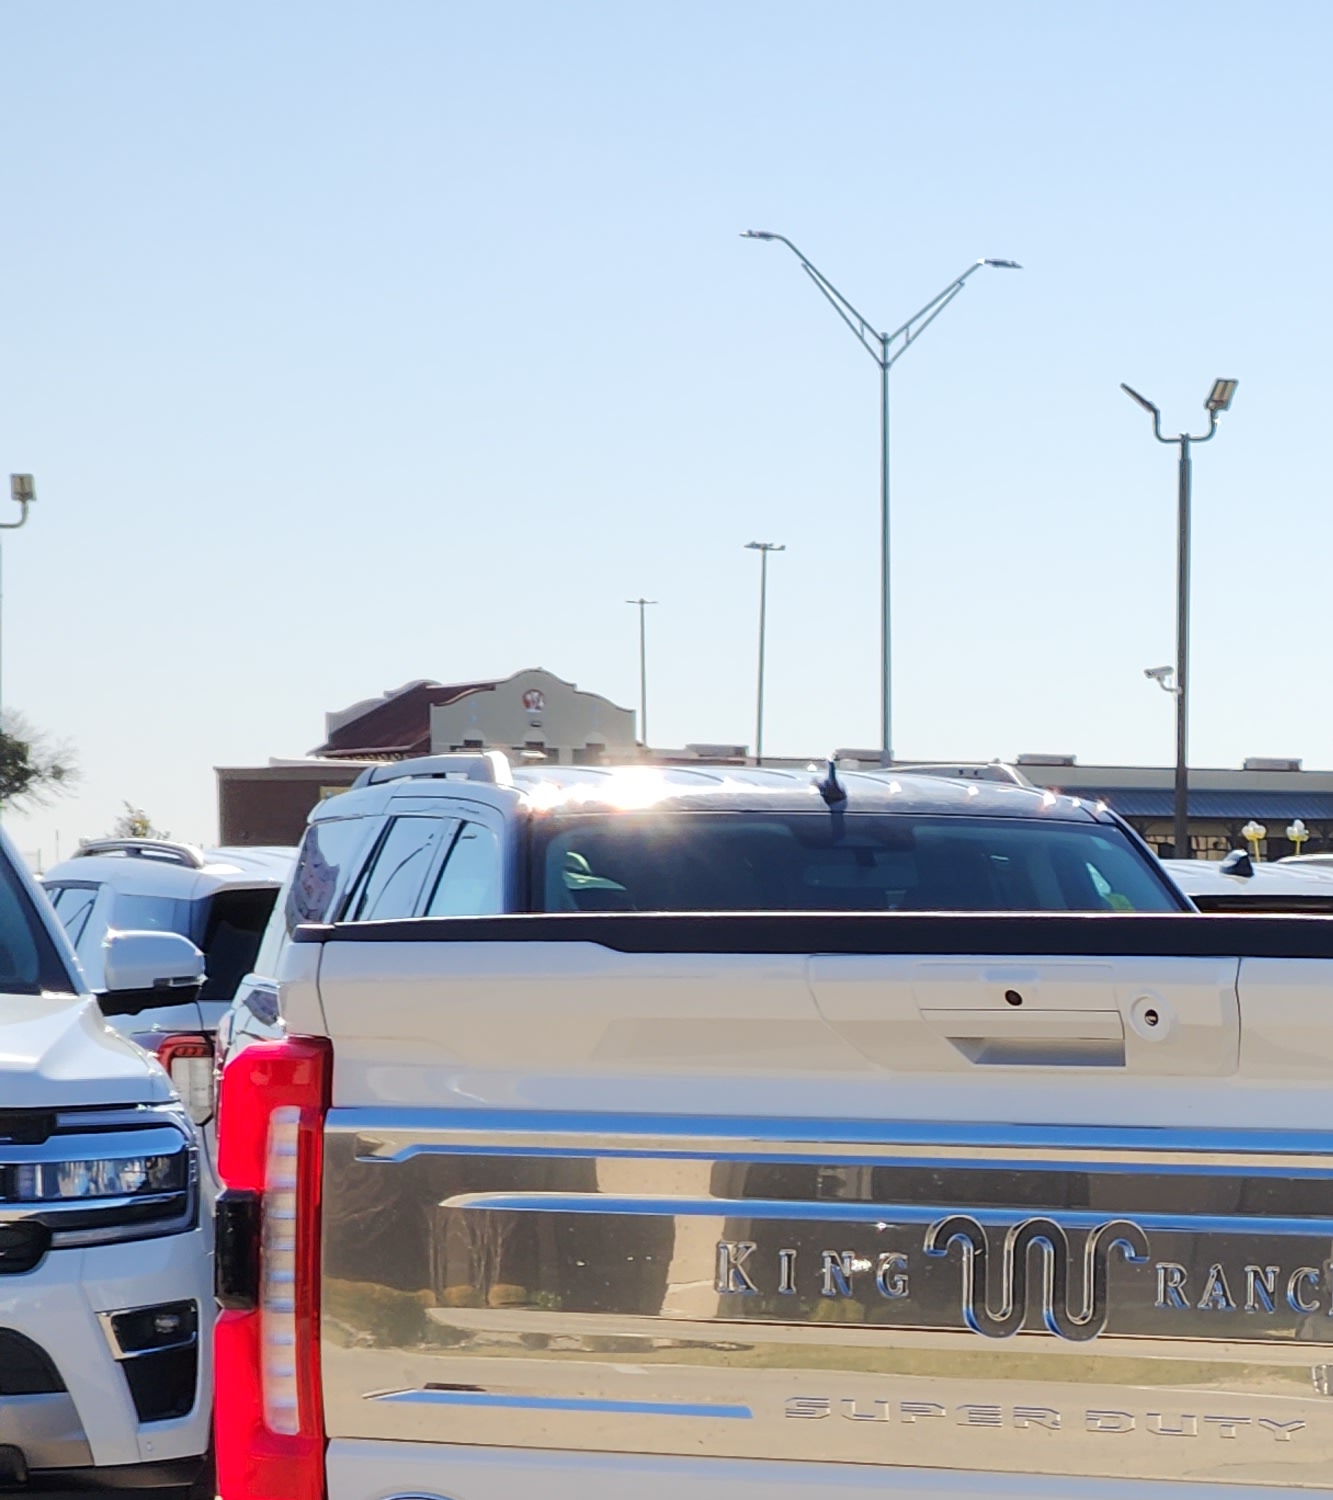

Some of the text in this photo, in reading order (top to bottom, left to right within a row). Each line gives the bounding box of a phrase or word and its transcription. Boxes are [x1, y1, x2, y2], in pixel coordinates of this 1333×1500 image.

[715, 1240, 910, 1299] KING
[784, 1396, 1307, 1442] SUPER DUTY
